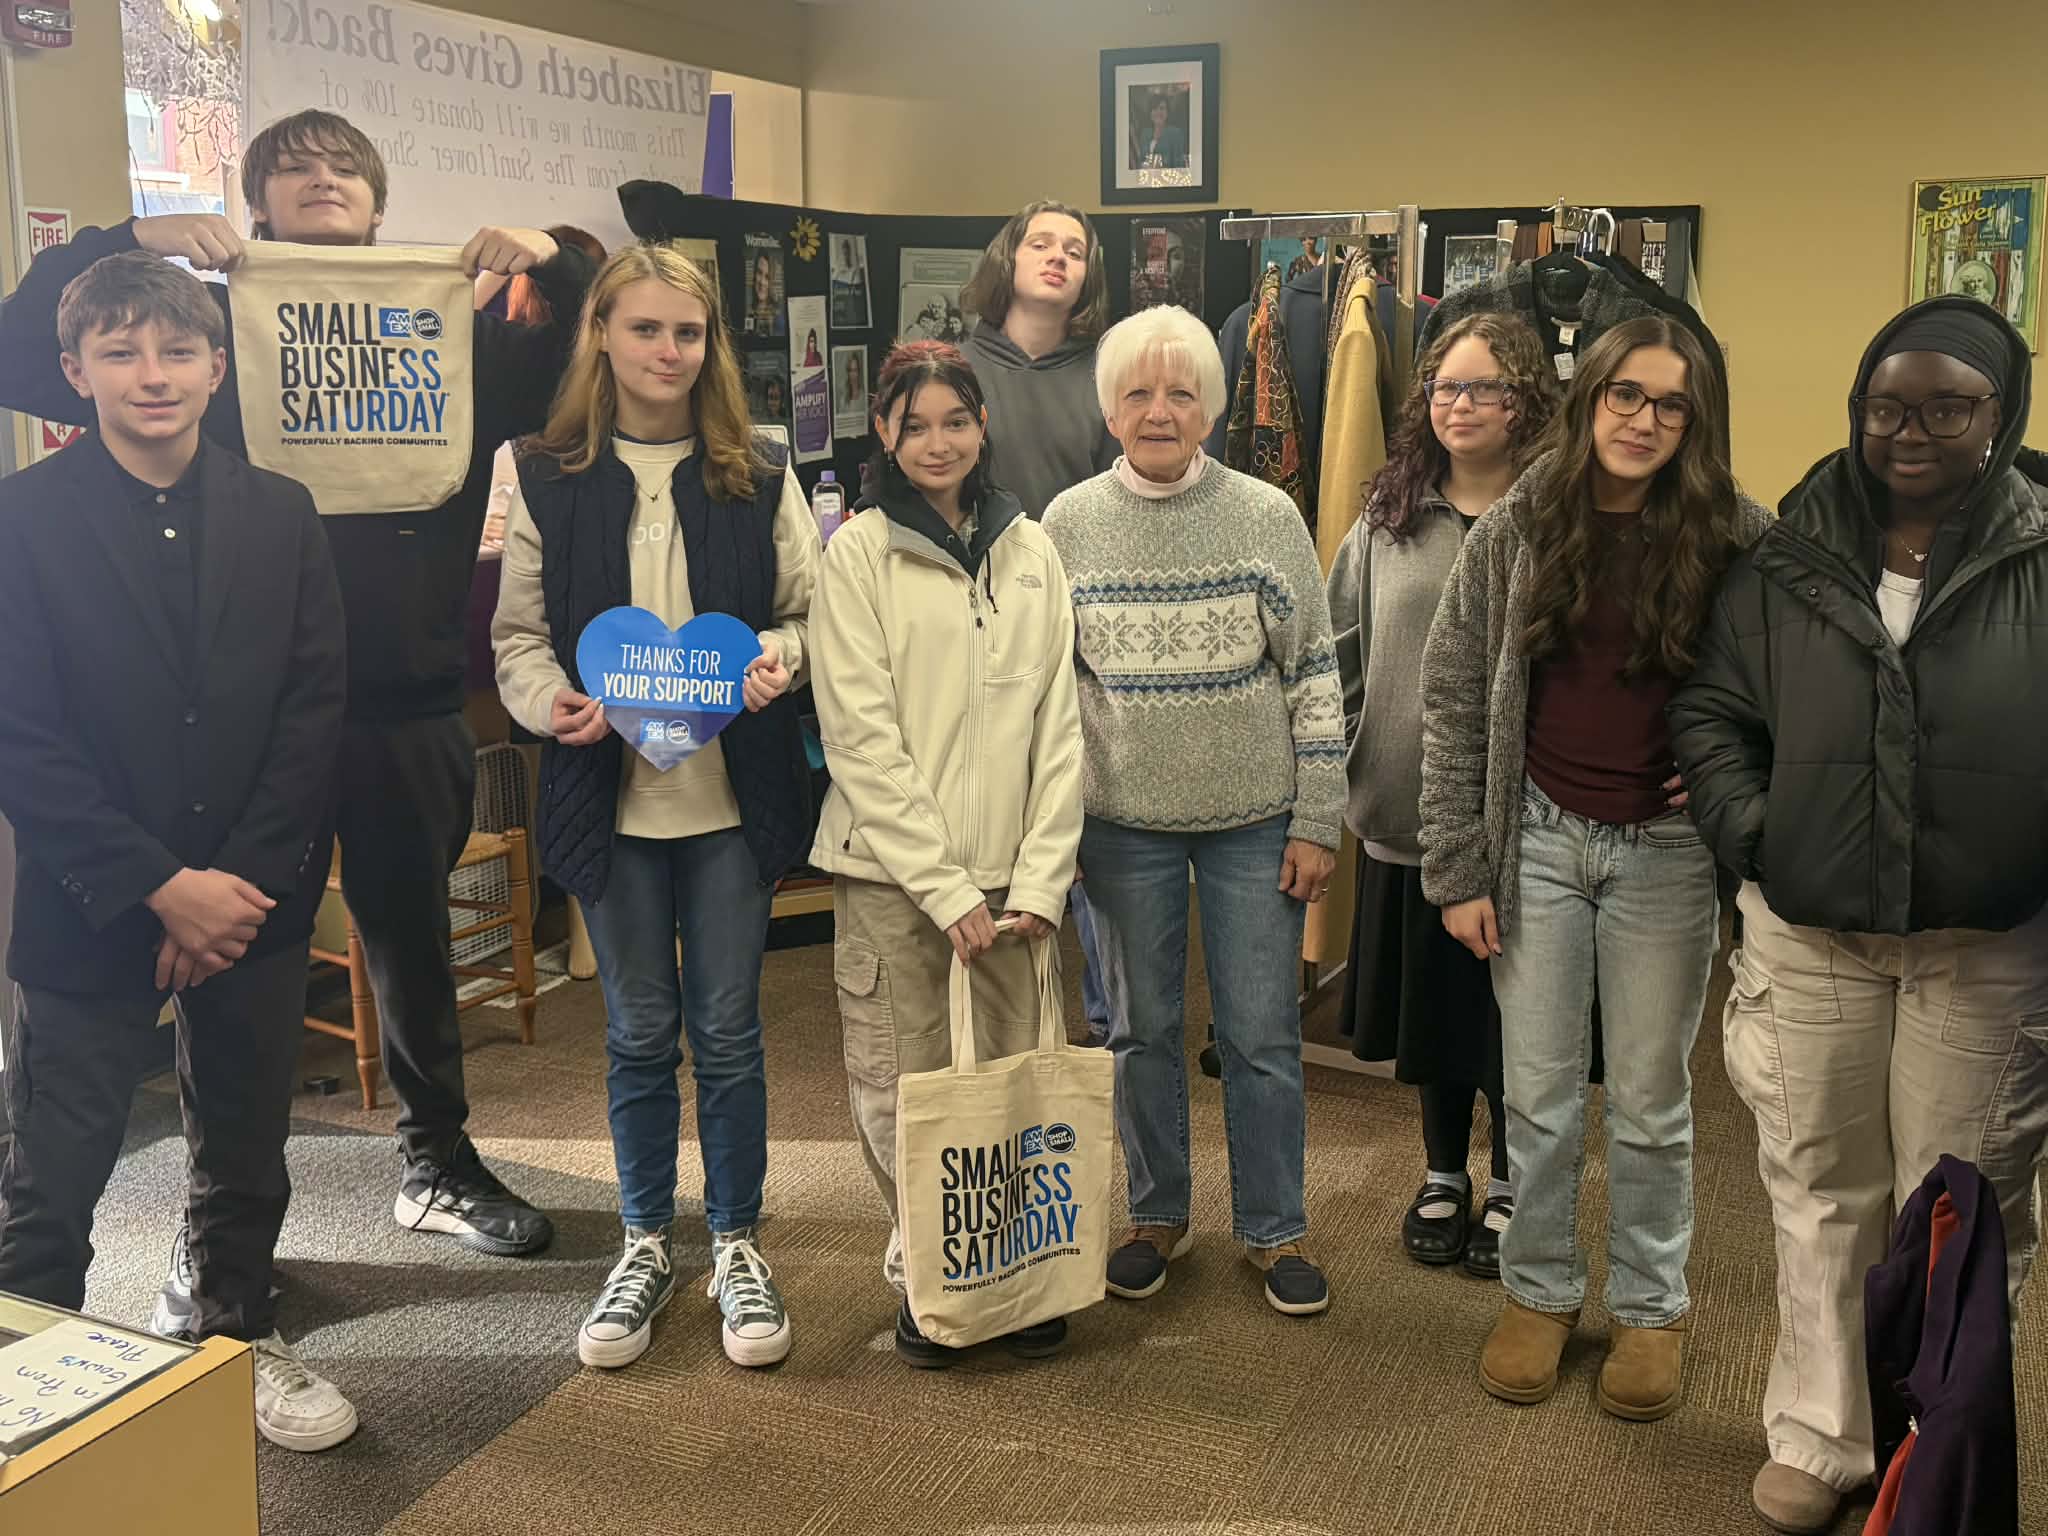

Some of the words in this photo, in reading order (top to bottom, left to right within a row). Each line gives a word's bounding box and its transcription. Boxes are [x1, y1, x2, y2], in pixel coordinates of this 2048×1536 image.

[33, 31, 65, 45] FIRE
[1938, 187, 1984, 212] Sun
[1920, 202, 1997, 238] Flower
[33, 227, 65, 247] FIRE
[277, 303, 381, 345] SMALL
[386, 311, 410, 323] AM
[390, 321, 410, 333] EX
[280, 346, 442, 390] BUSINESS
[281, 390, 447, 433] SATURDAY
[281, 437, 341, 446] POWERFULLY
[344, 437, 384, 446] BACKING
[386, 437, 448, 447] COMMUNITIES
[620, 644, 685, 674] THANKS
[689, 649, 721, 676] FOR
[603, 672, 650, 700] YOUR
[653, 675, 736, 705] SUPPORT
[1023, 1129, 1043, 1145] AM
[1026, 1139, 1043, 1152] EX
[1047, 1130, 1068, 1141] SHOP
[1049, 1135, 1072, 1147] SMALL
[940, 1132, 1022, 1191] SMALL
[942, 1161, 1073, 1237] BUSINESS
[943, 1203, 1079, 1281] SATURDAY
[943, 1277, 997, 1294] POWERFULLY
[998, 1263, 1027, 1283] BACKING
[1027, 1248, 1081, 1269] COMMUNITIES
[86, 1331, 149, 1362] Please
[16, 1365, 65, 1398] Prom
